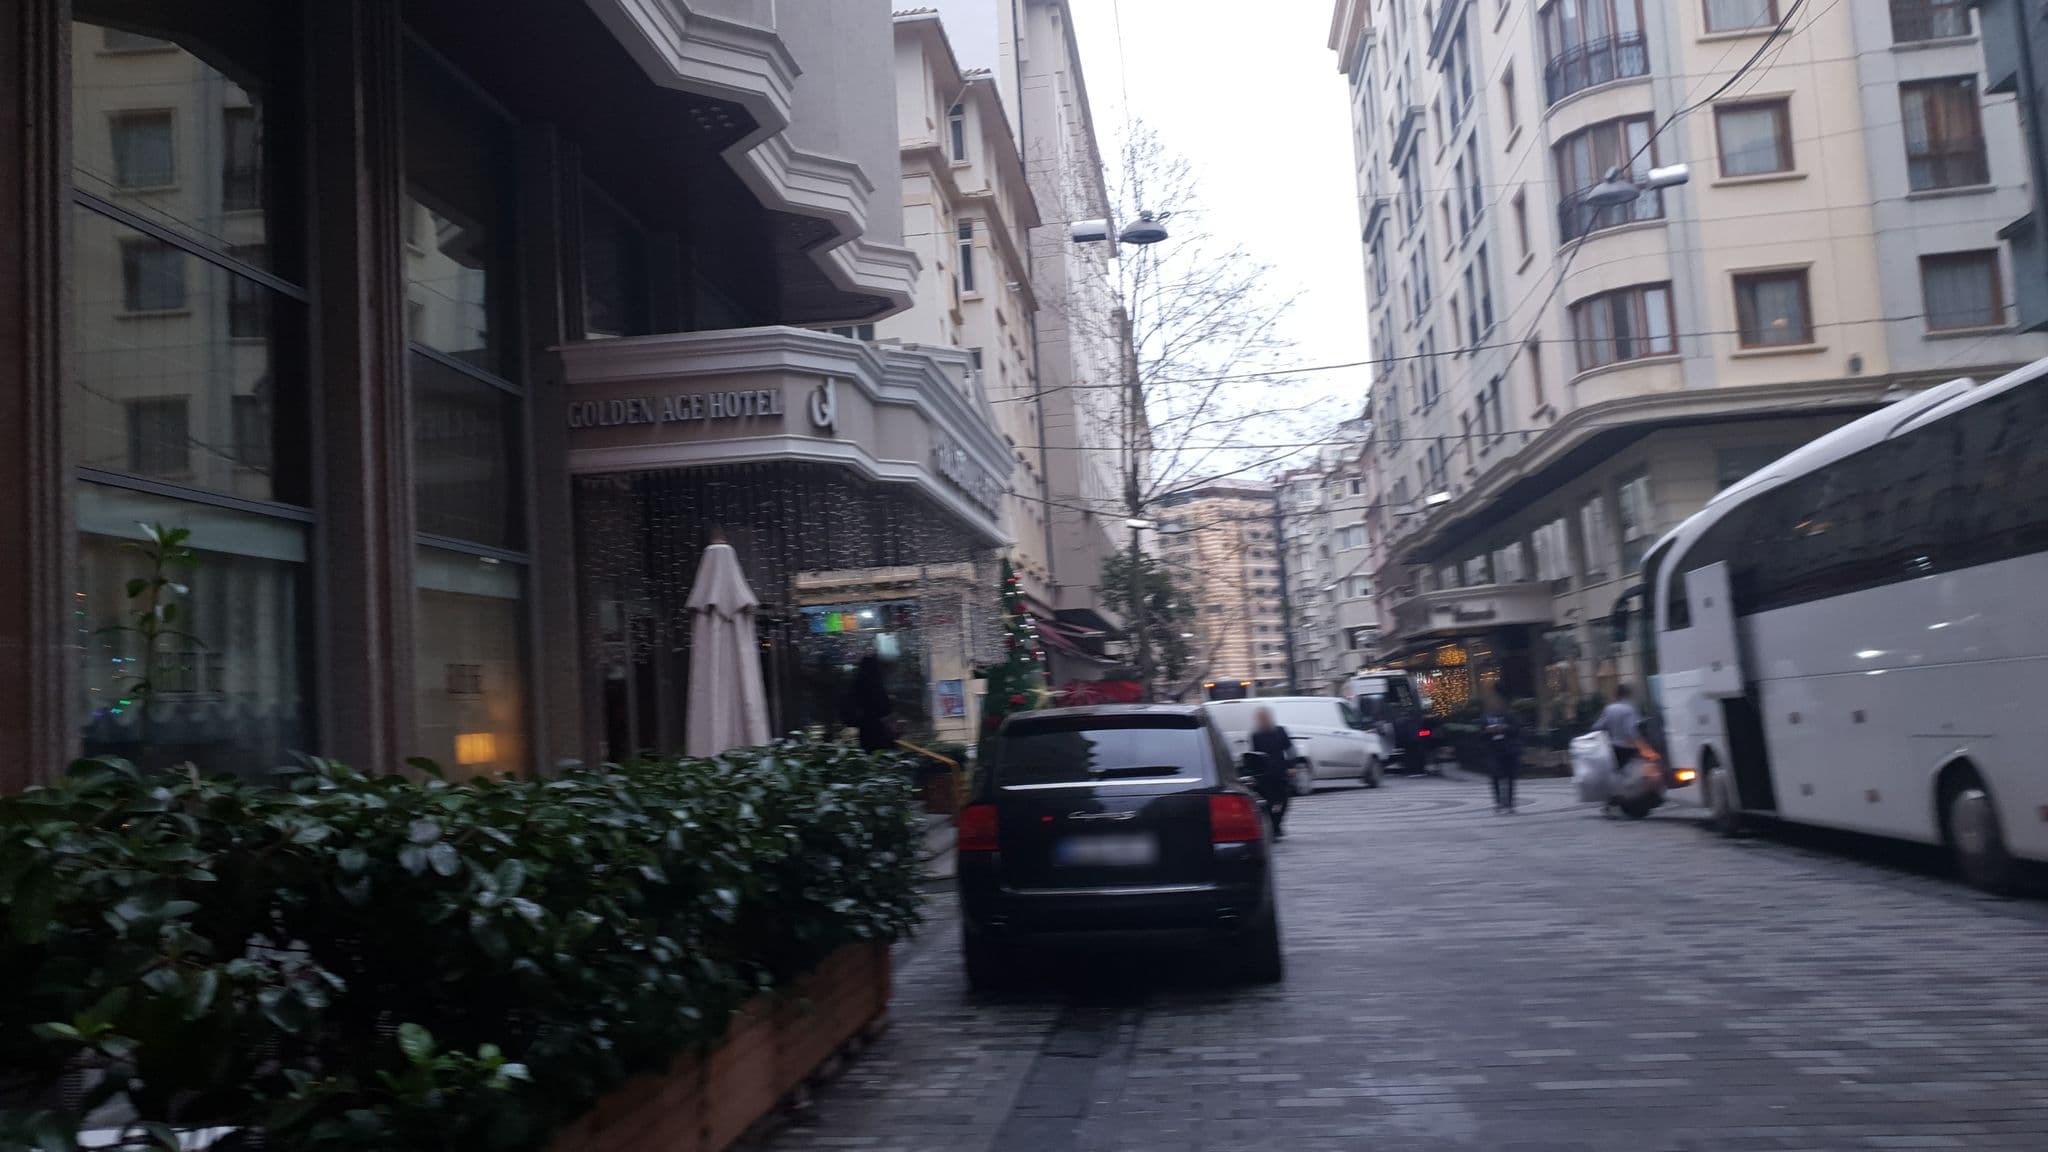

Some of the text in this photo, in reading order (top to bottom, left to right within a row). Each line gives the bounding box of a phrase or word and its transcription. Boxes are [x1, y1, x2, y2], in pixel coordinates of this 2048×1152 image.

[568, 389, 784, 428] GOLDEN AGE HOTEL
